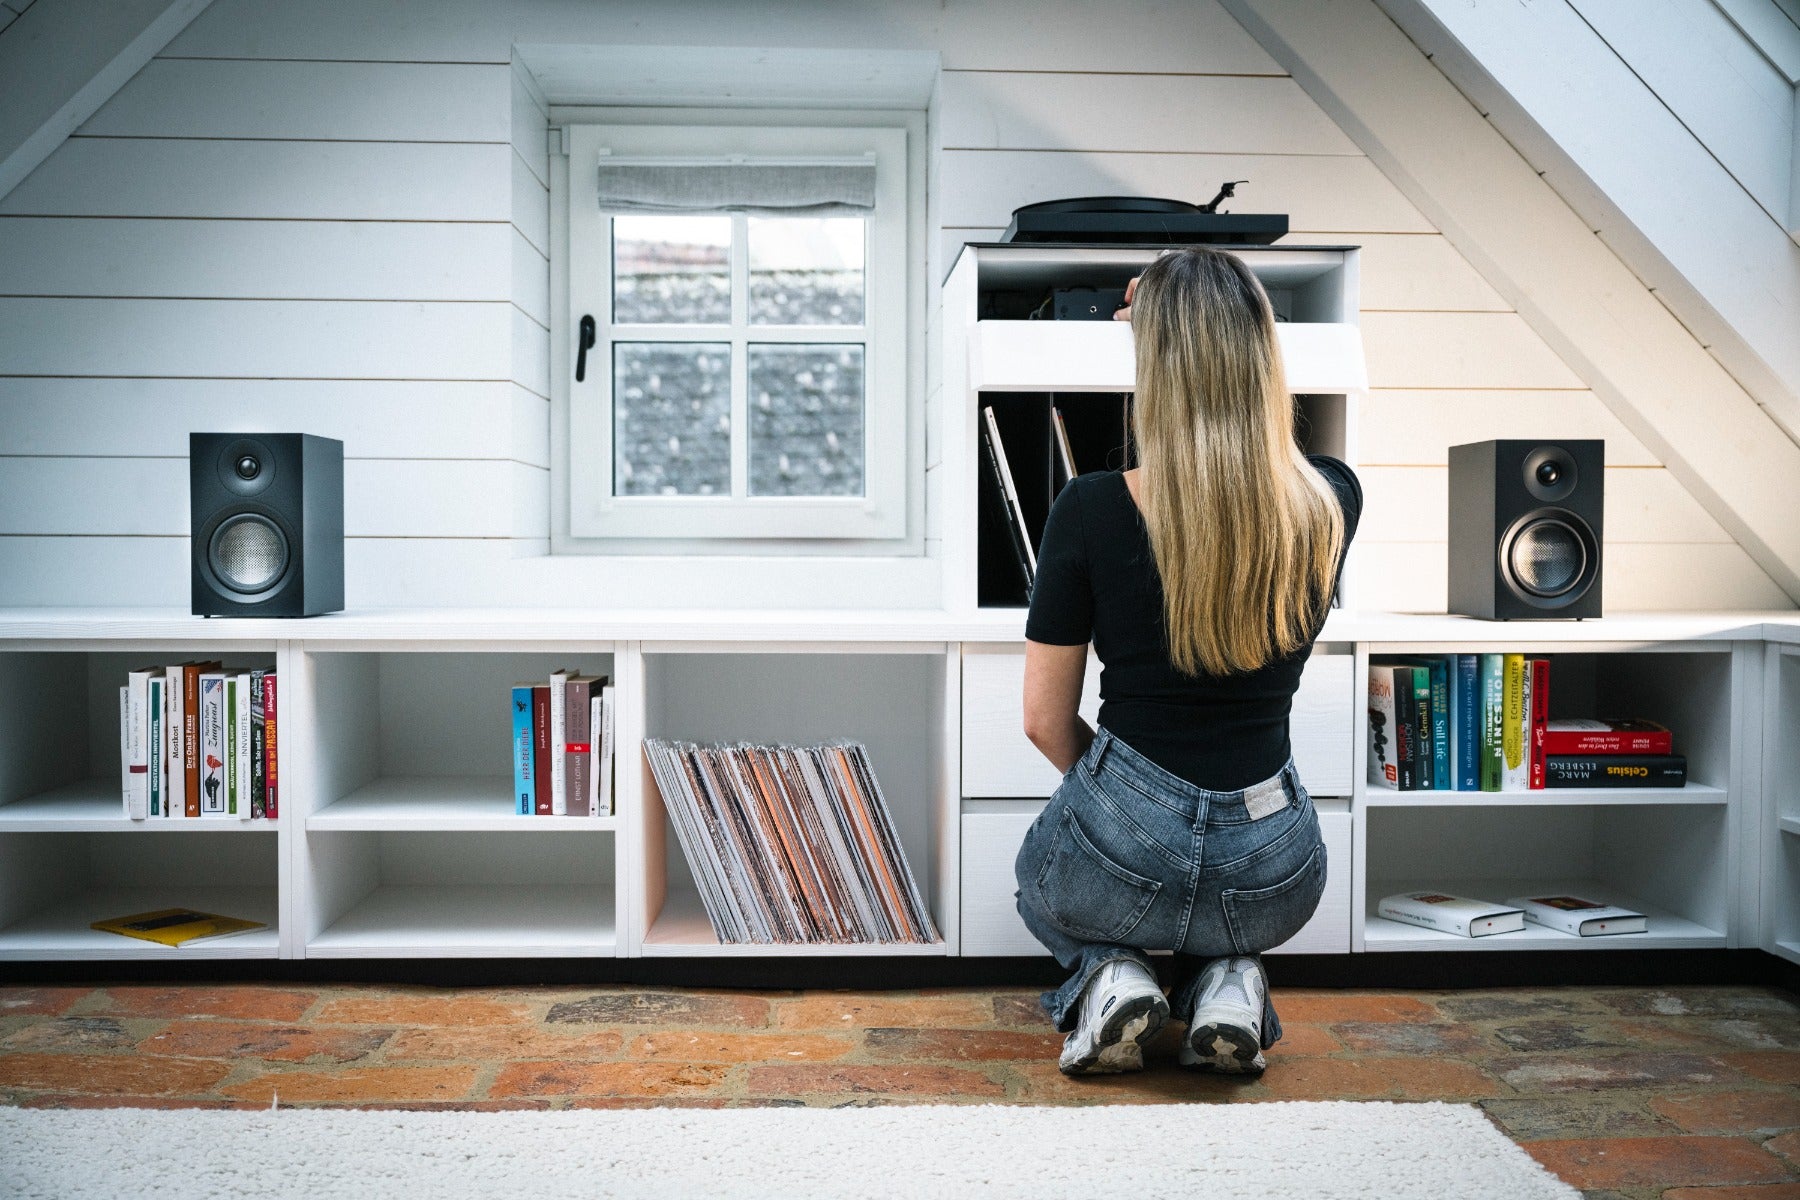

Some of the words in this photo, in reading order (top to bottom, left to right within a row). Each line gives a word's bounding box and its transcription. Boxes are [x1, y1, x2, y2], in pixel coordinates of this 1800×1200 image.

[208, 701, 222, 748] Zuagroast
[1419, 702, 1428, 739] Glennkill
[1436, 720, 1446, 739] Still
[1494, 669, 1502, 757] NINCSHOF
[266, 720, 276, 749] PASSAU
[1405, 722, 1413, 762] ACHTSAM
[1436, 742, 1446, 760] Life
[1607, 767, 1648, 776] Celsius
